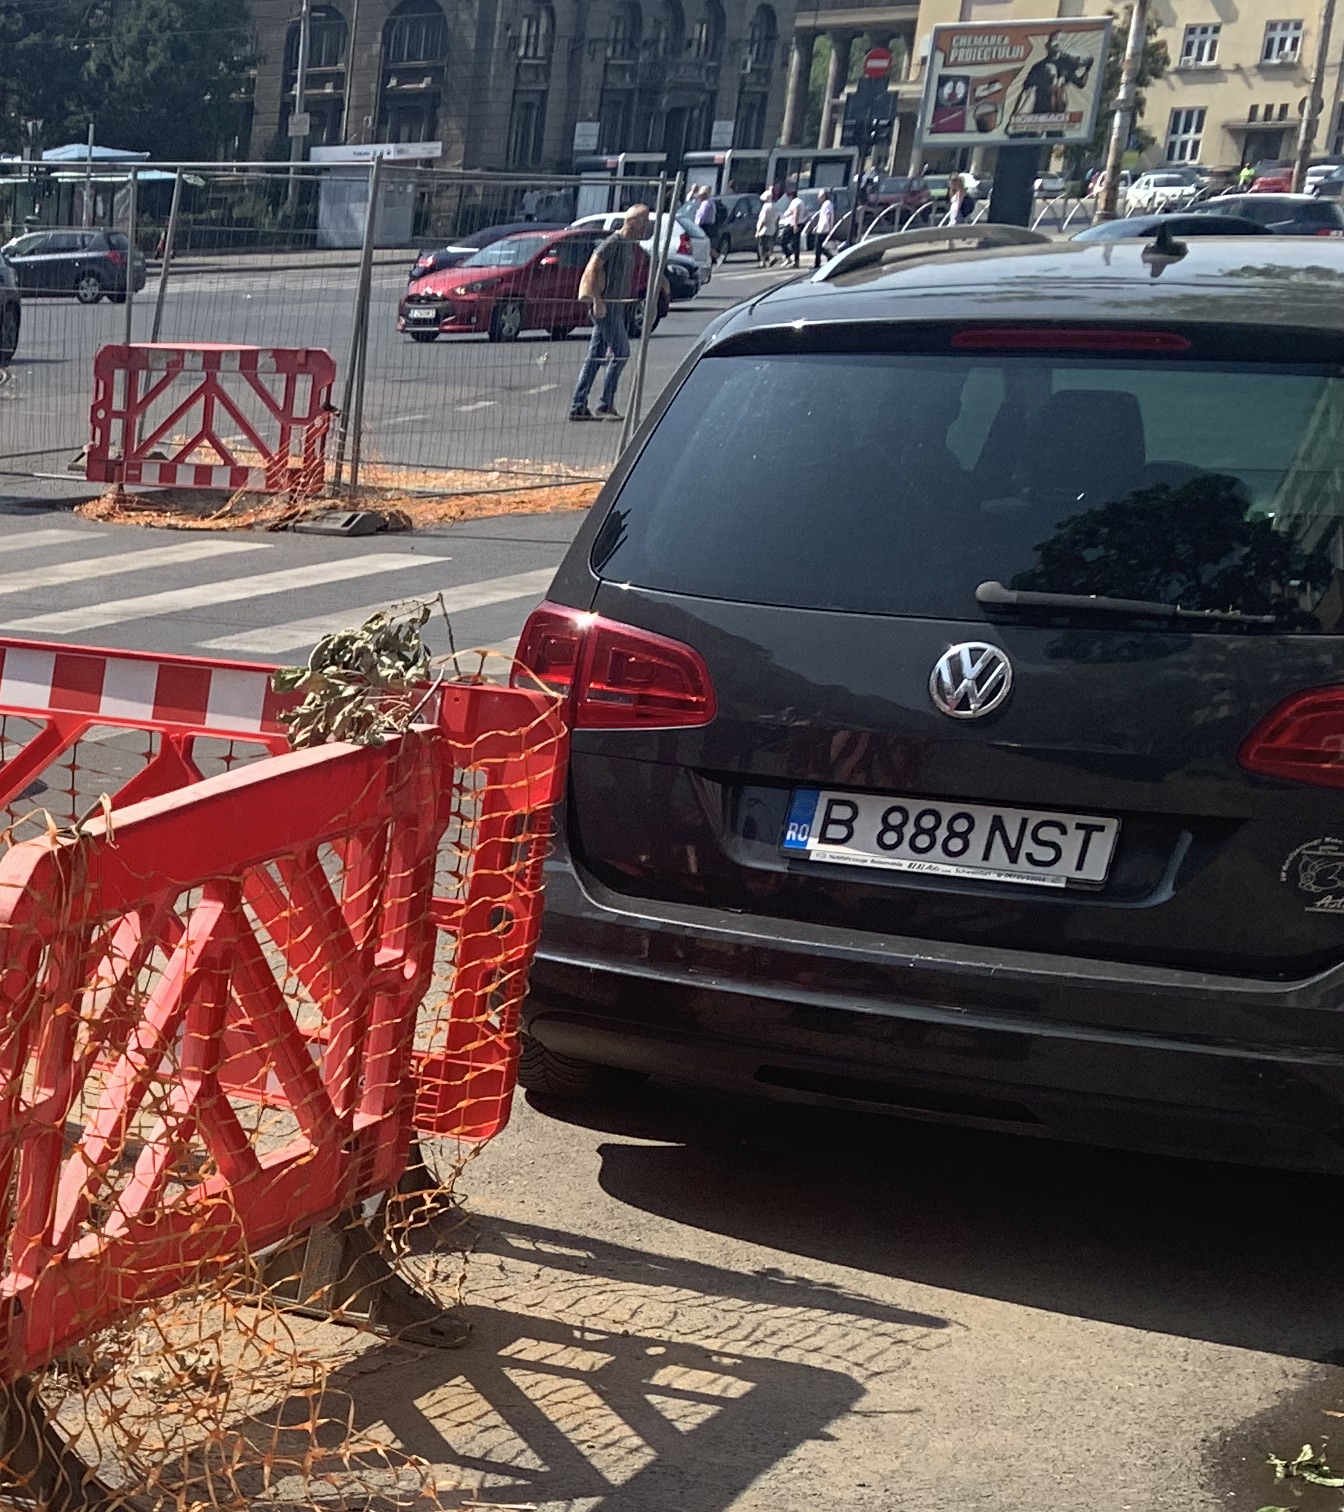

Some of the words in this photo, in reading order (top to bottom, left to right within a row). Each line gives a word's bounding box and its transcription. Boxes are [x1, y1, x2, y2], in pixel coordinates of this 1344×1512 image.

[952, 34, 1010, 47] CHEMAREA
[949, 46, 1024, 62] PROIECTULUI
[786, 822, 810, 842] RO
[818, 798, 858, 845] B
[876, 805, 975, 858] 888
[981, 814, 1106, 872] NST
